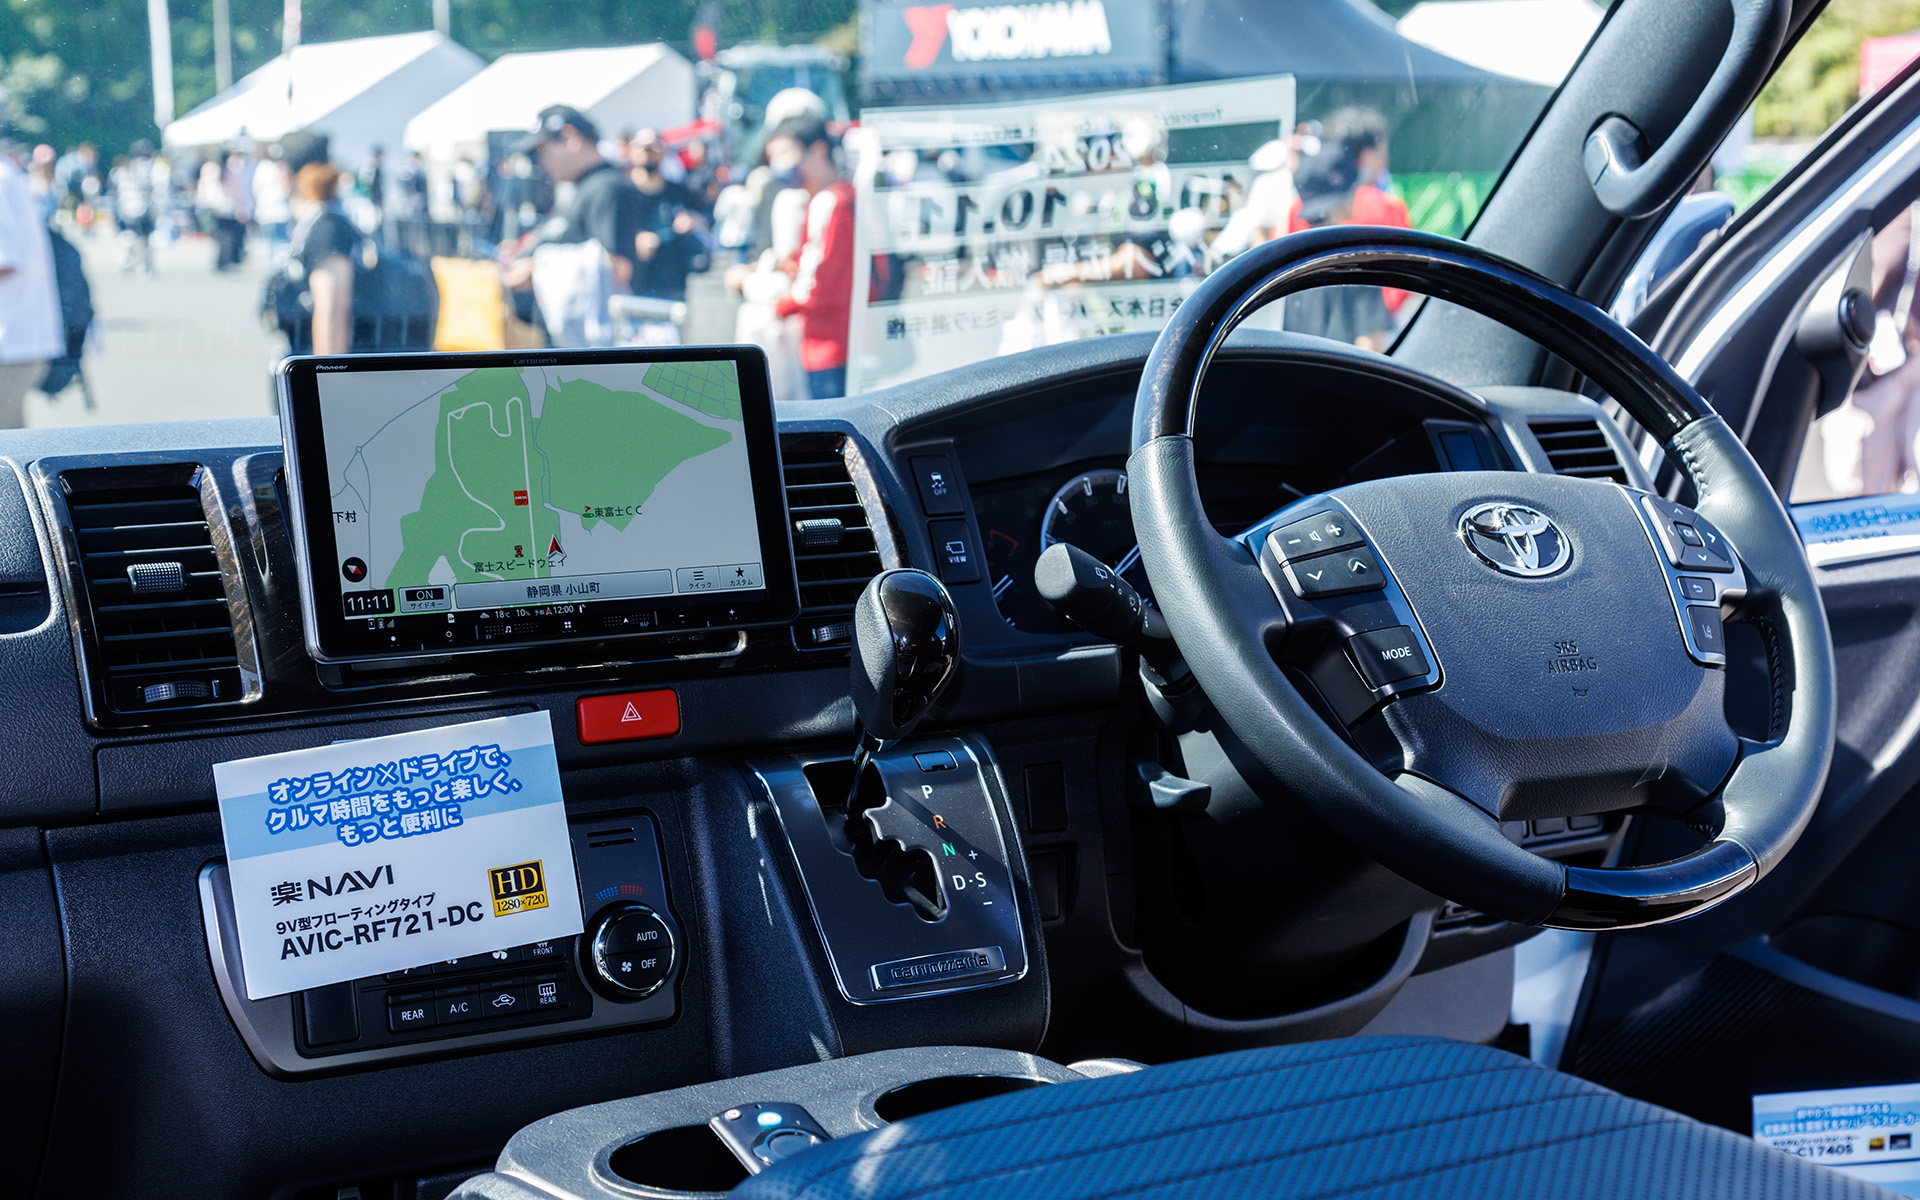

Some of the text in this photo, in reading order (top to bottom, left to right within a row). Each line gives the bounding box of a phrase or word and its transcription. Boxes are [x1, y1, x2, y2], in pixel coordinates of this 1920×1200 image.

[933, 488, 947, 496] OFF
[332, 510, 357, 523] 下村
[473, 558, 565, 573] 富士スピードウェイ
[948, 555, 967, 564] VIEW
[526, 582, 600, 598] 静岡県 小山町
[688, 582, 712, 590] クイック
[730, 579, 754, 587] カスタム
[416, 590, 434, 600] ON
[348, 595, 389, 611] 11:11
[553, 605, 574, 614] 12:00
[1381, 646, 1412, 661] MODE
[1554, 640, 1579, 654] SRS
[1549, 656, 1598, 675] AIRBAG
[921, 784, 933, 799] P
[266, 771, 522, 834] クルマ時間をもっと楽しく、
[338, 804, 463, 846] もっと便利に
[932, 814, 947, 829] R
[942, 842, 956, 857] N
[495, 867, 540, 895] HD
[275, 892, 436, 935] 9V型フローティングタイプ
[280, 901, 484, 960] AVIC-RF721-DC
[636, 930, 658, 942] AUTO
[533, 946, 554, 956] FRONT
[641, 958, 657, 969] OFF
[891, 952, 990, 980] carrozzeria
[540, 996, 557, 1005] REAR
[401, 1008, 424, 1021] REAR
[450, 1002, 469, 1014] A/C
